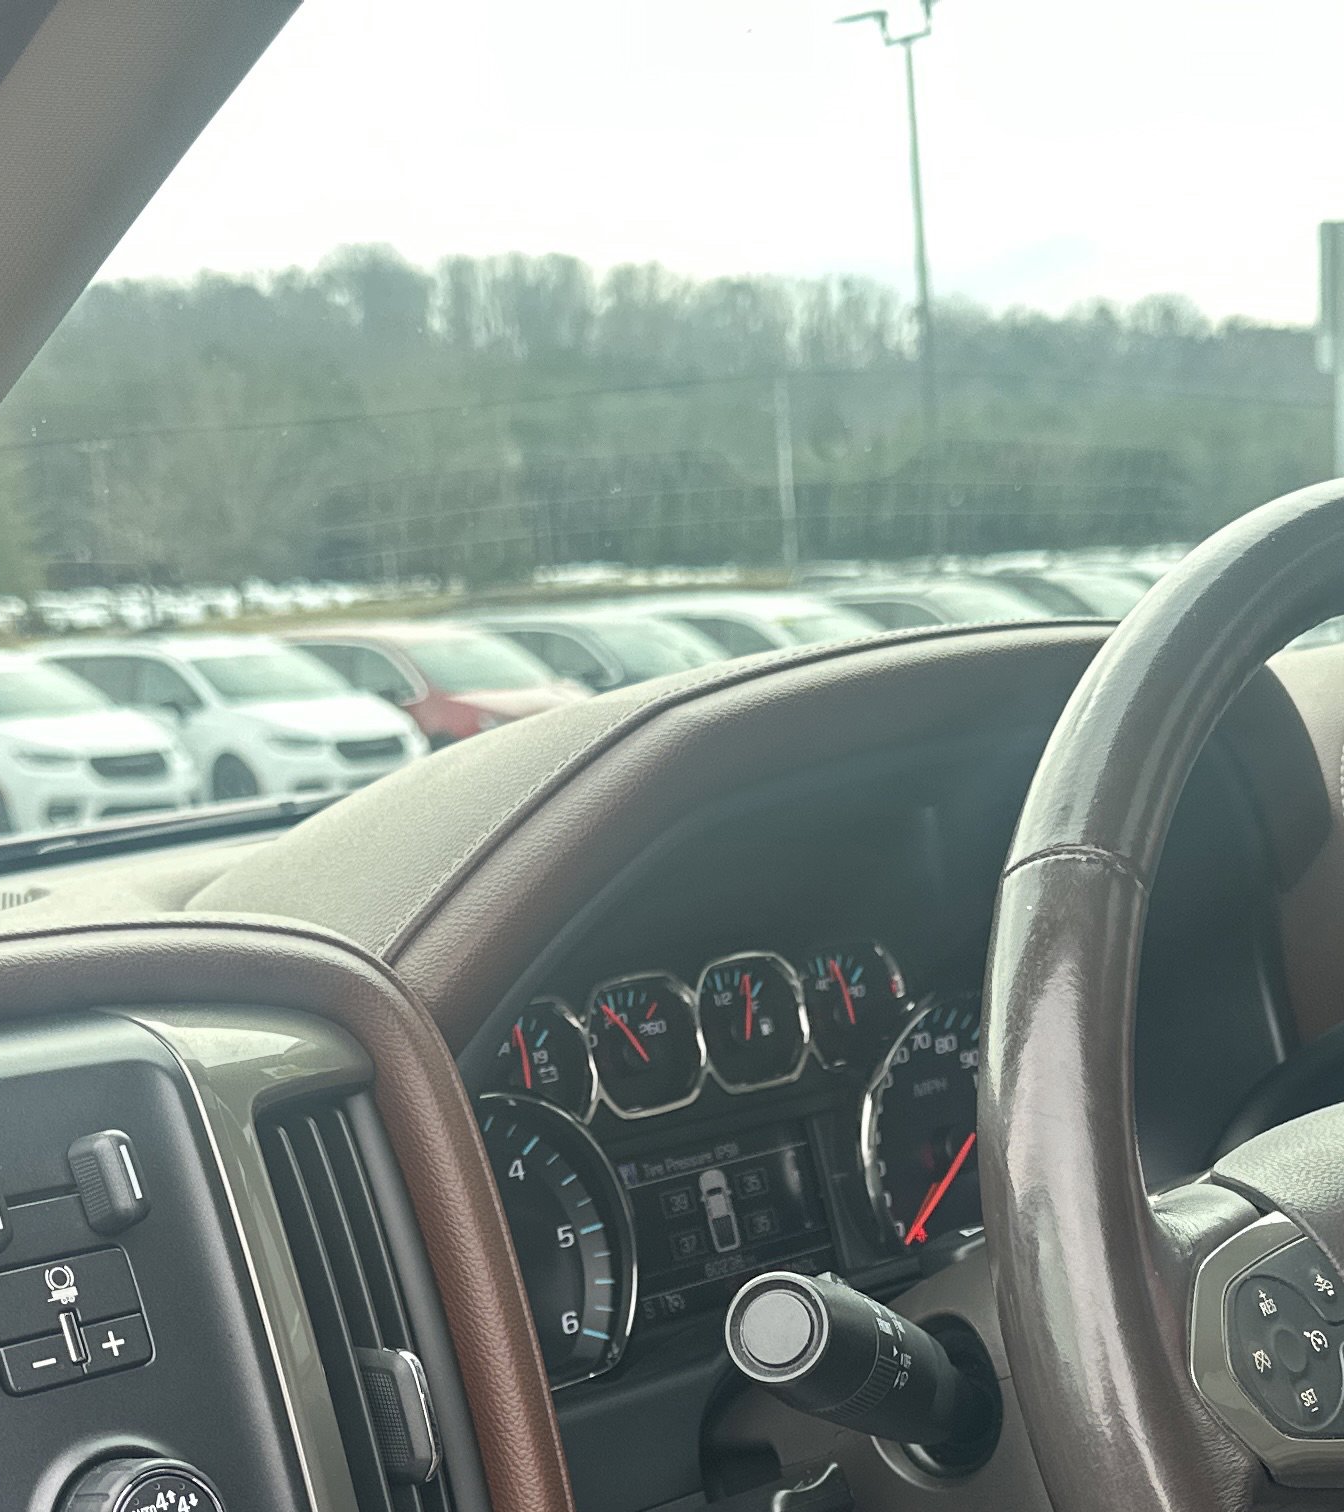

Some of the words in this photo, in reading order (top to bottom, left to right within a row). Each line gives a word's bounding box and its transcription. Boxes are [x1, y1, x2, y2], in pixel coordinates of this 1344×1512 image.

[911, 1032, 931, 1050] 70
[935, 1033, 958, 1055] 80
[913, 1077, 948, 1098] MPH
[508, 1159, 526, 1181] 4
[556, 1224, 575, 1248] 5
[1259, 1298, 1277, 1316] RES
[561, 1310, 579, 1335] 6
[1300, 1388, 1318, 1407] SET
